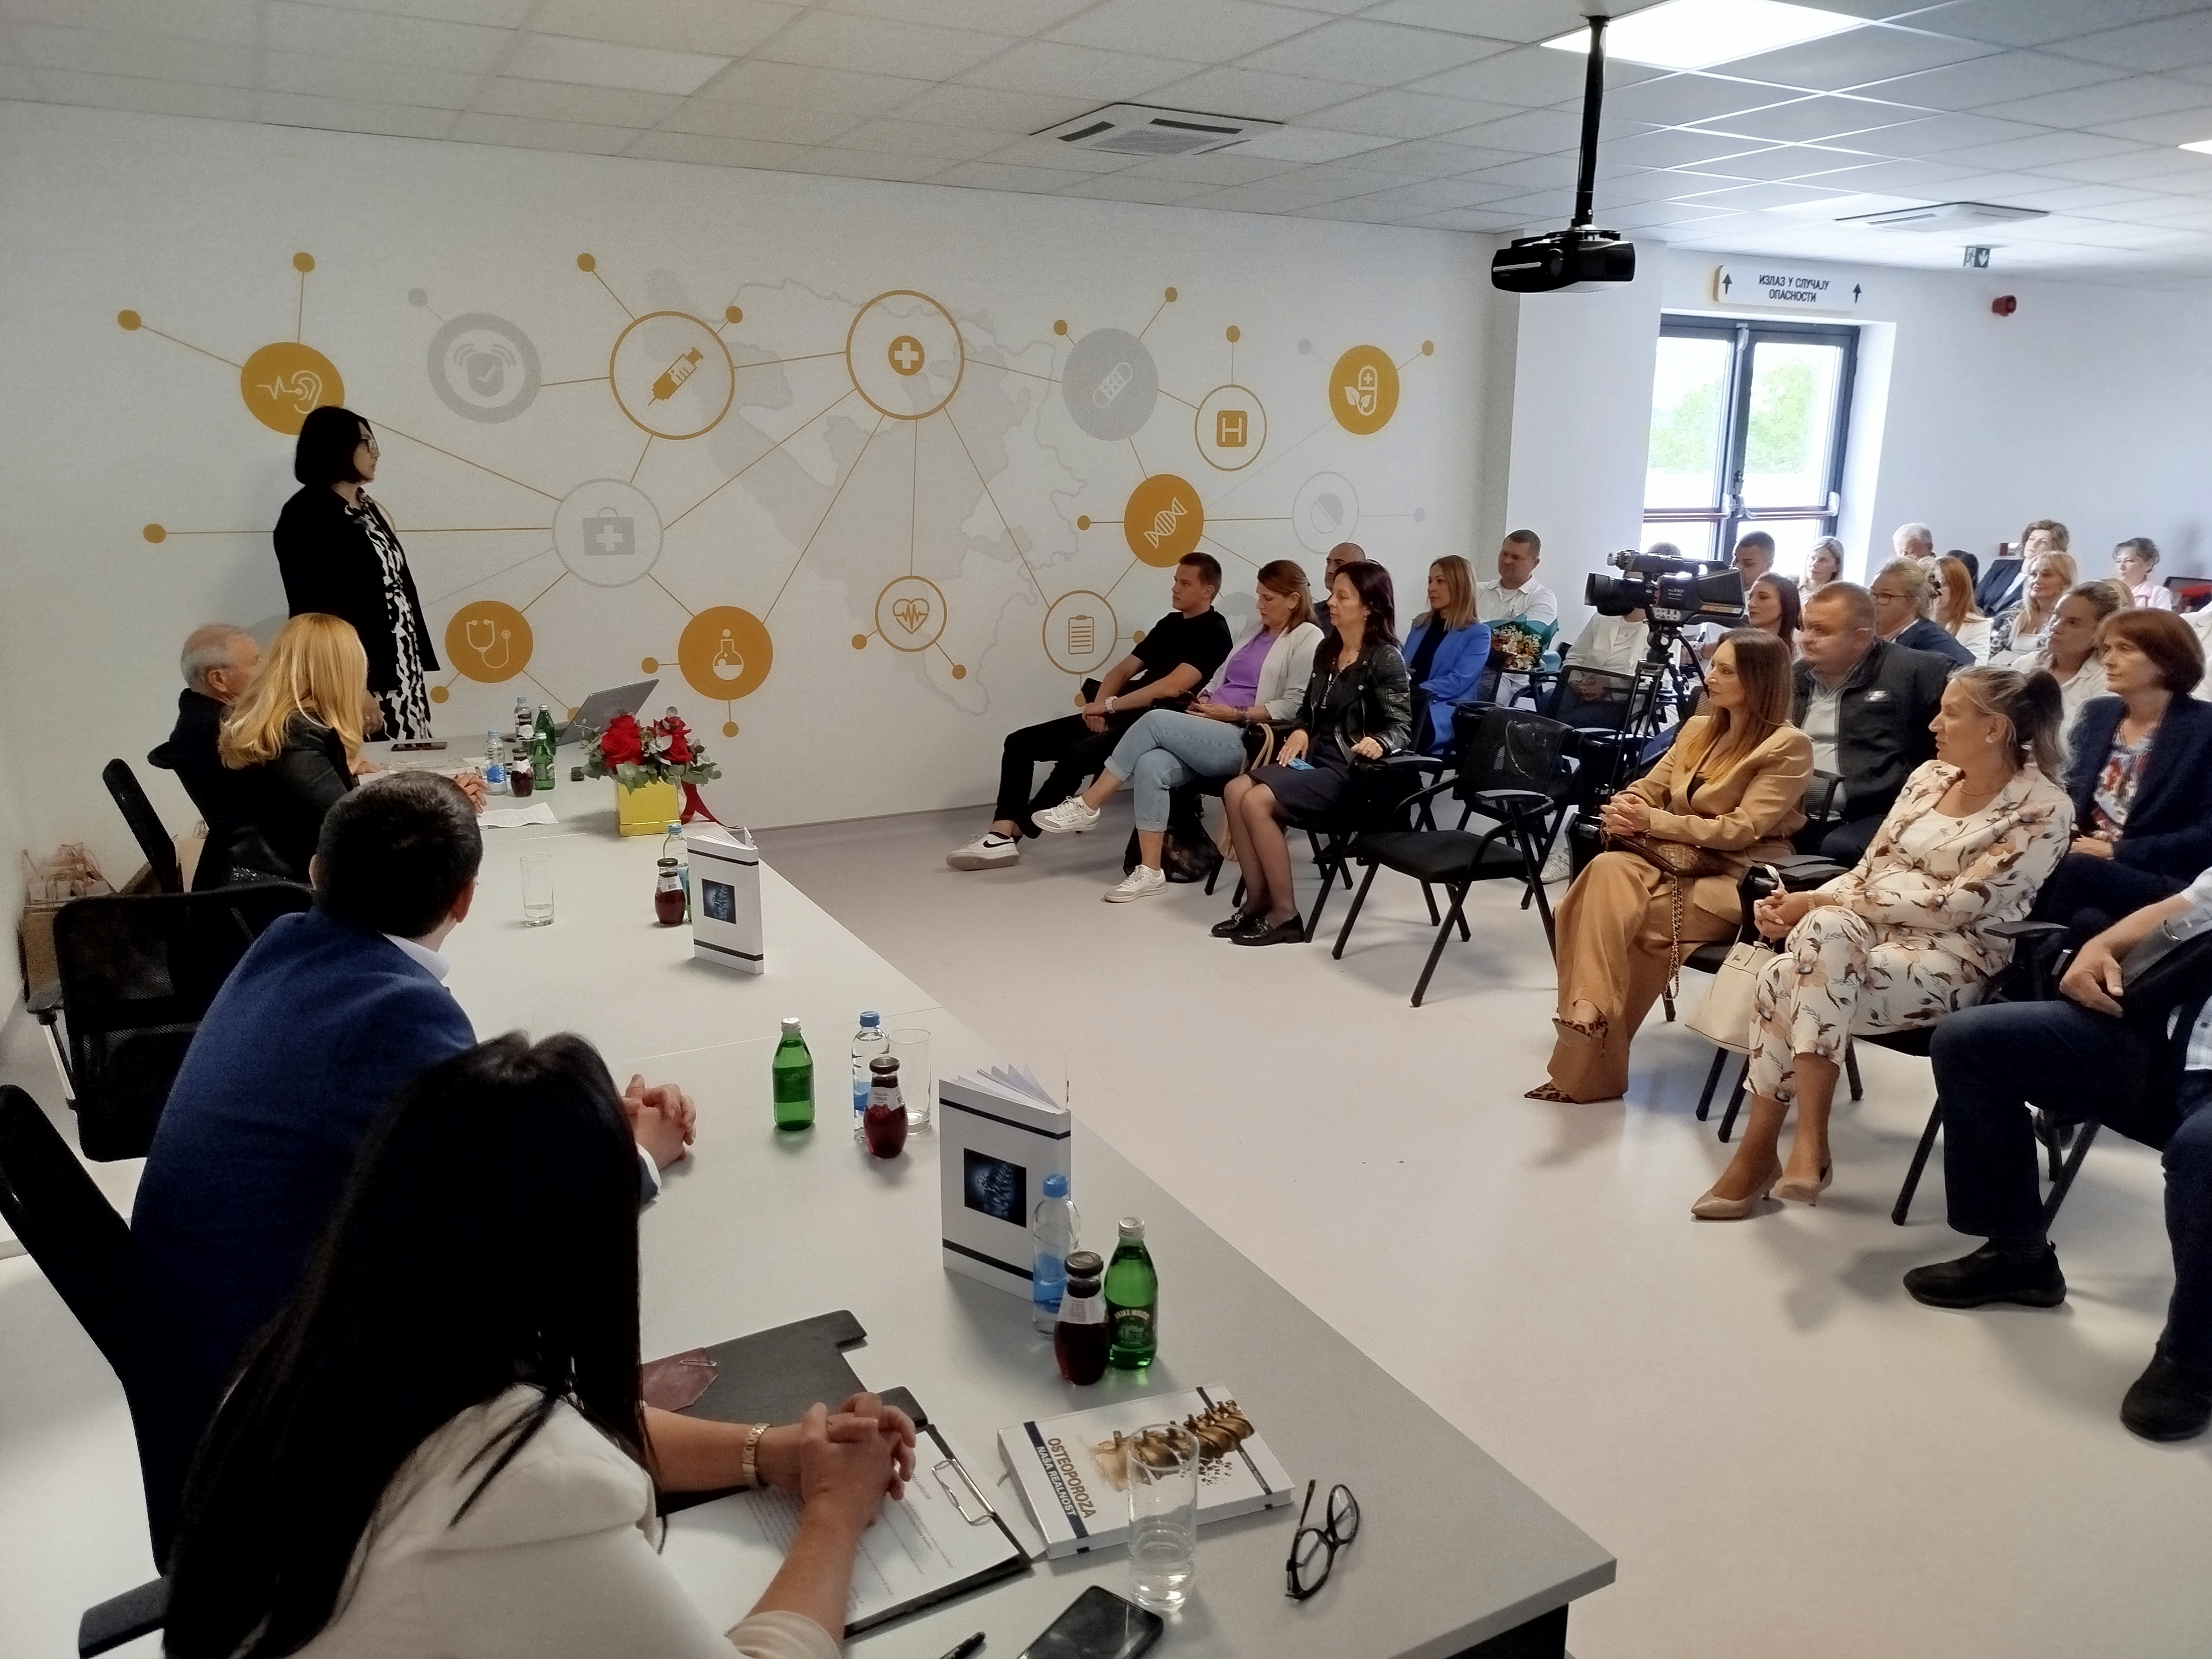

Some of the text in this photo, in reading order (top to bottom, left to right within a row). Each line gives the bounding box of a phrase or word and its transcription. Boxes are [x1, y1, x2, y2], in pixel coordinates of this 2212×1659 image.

[1759, 275, 1829, 290] ИЗЛАЗ У СЛУЧАЈУ
[1769, 289, 1817, 302] ОПАСНОСТИ
[1222, 417, 1242, 442] H
[1048, 1438, 1097, 1519] OSTEOPOROZA
[1047, 1470, 1077, 1516] REALNOST
